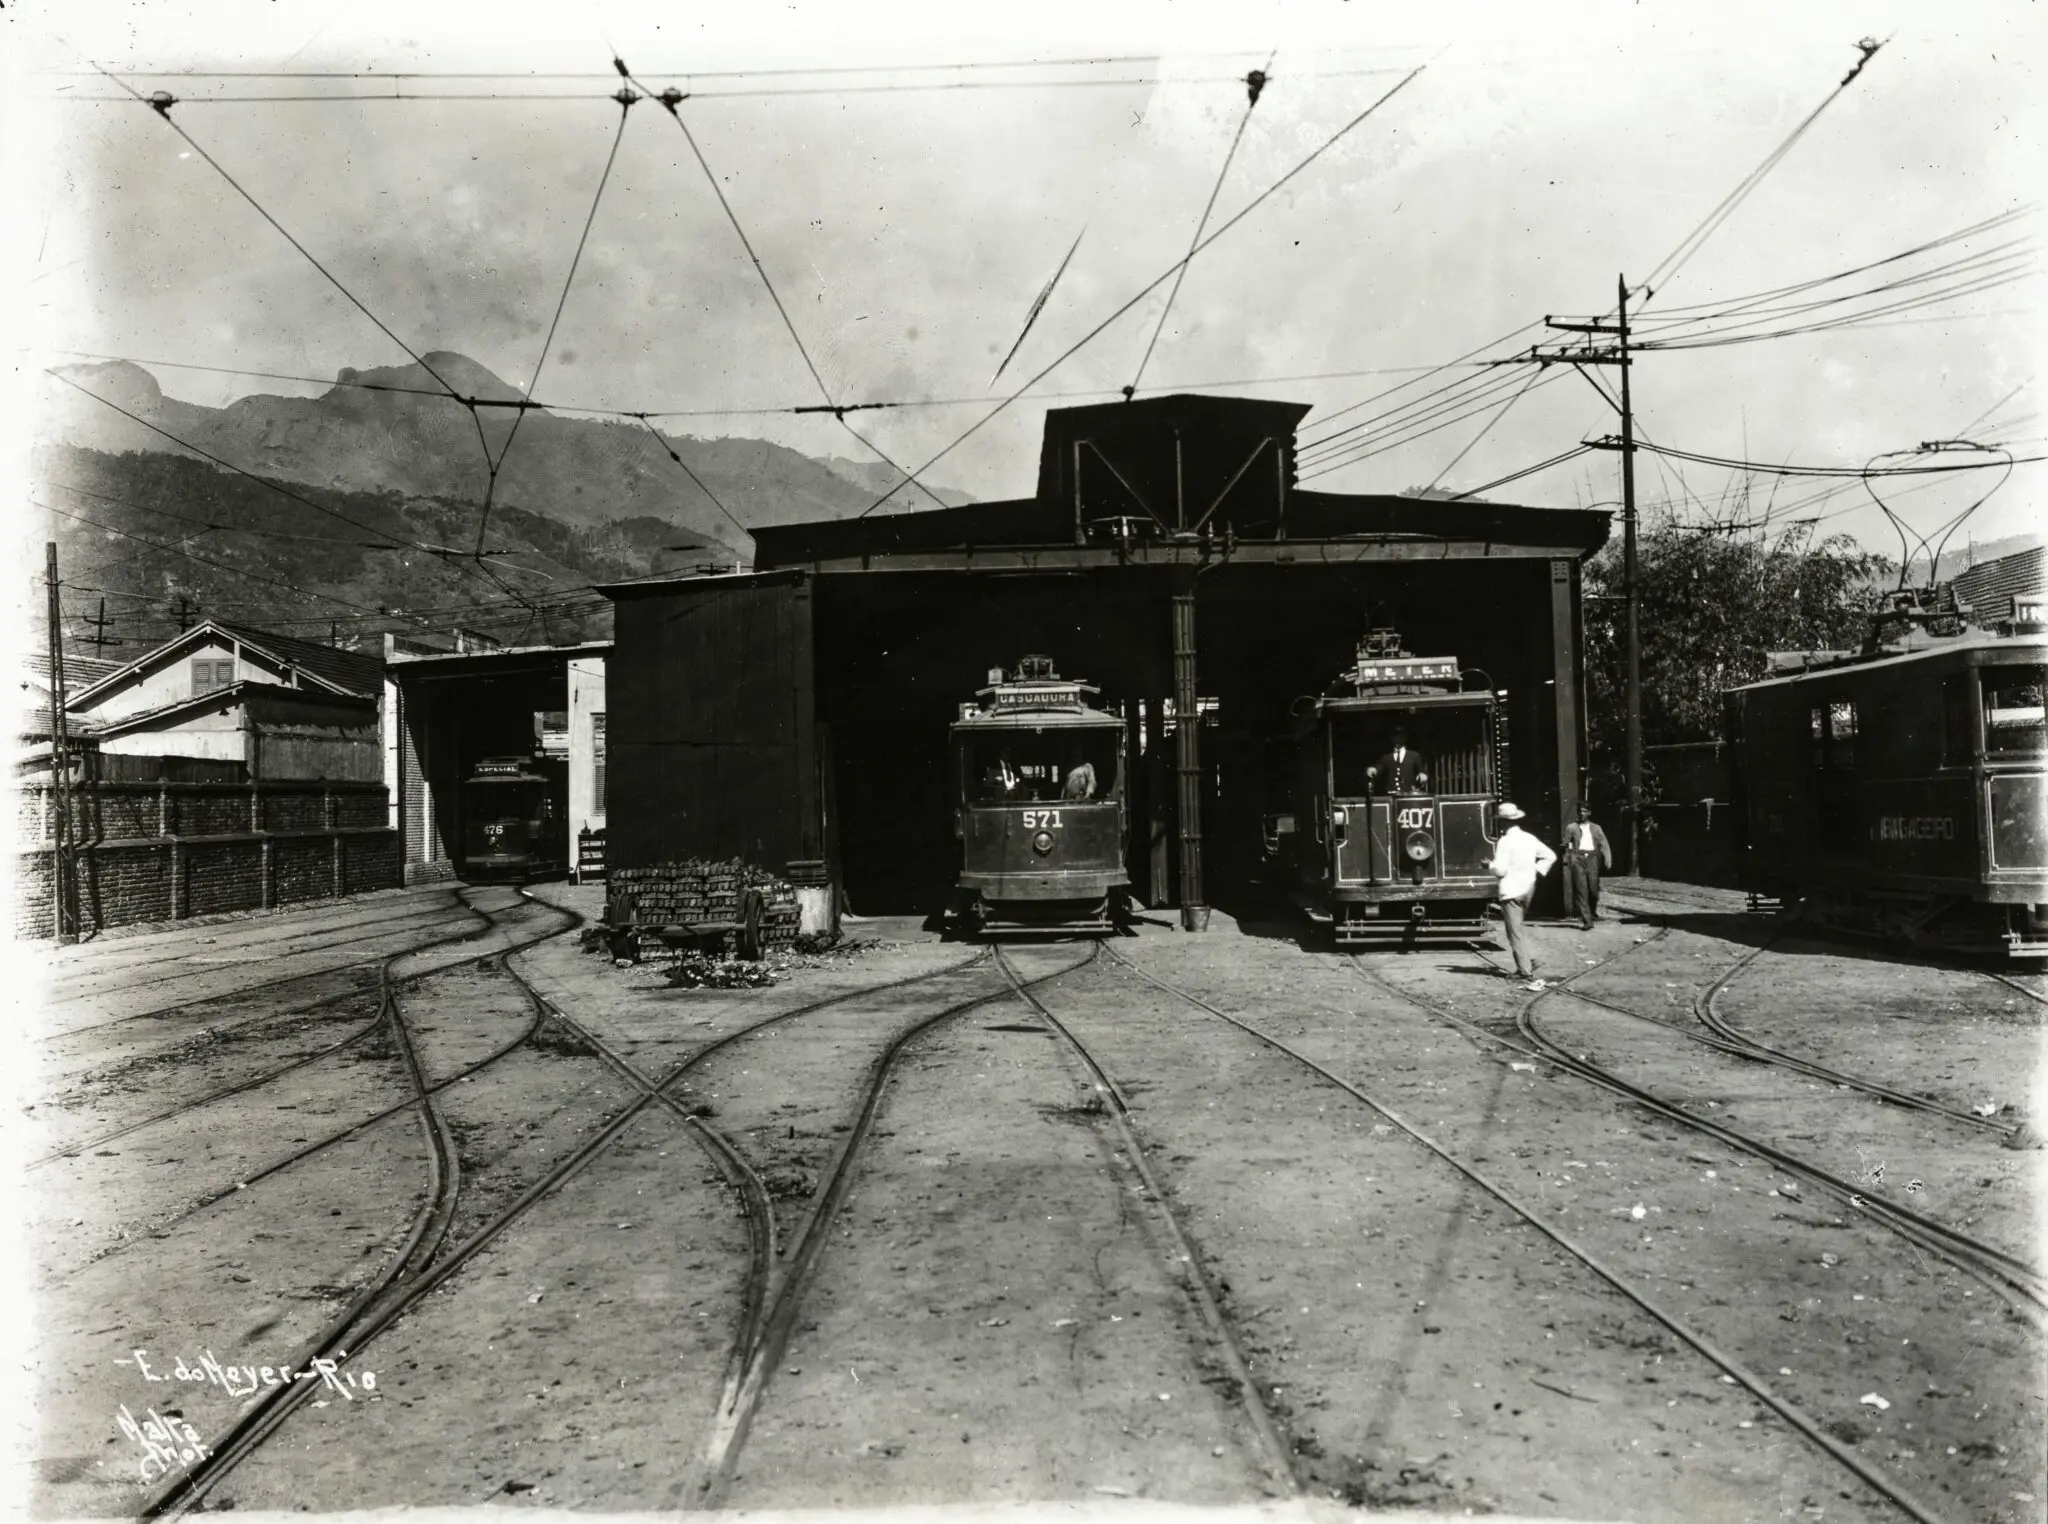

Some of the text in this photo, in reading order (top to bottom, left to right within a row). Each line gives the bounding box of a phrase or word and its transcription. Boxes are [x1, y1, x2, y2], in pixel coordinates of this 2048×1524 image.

[1022, 811, 1064, 828] 571
[1397, 808, 1434, 828] 407
[484, 825, 503, 834] 476
